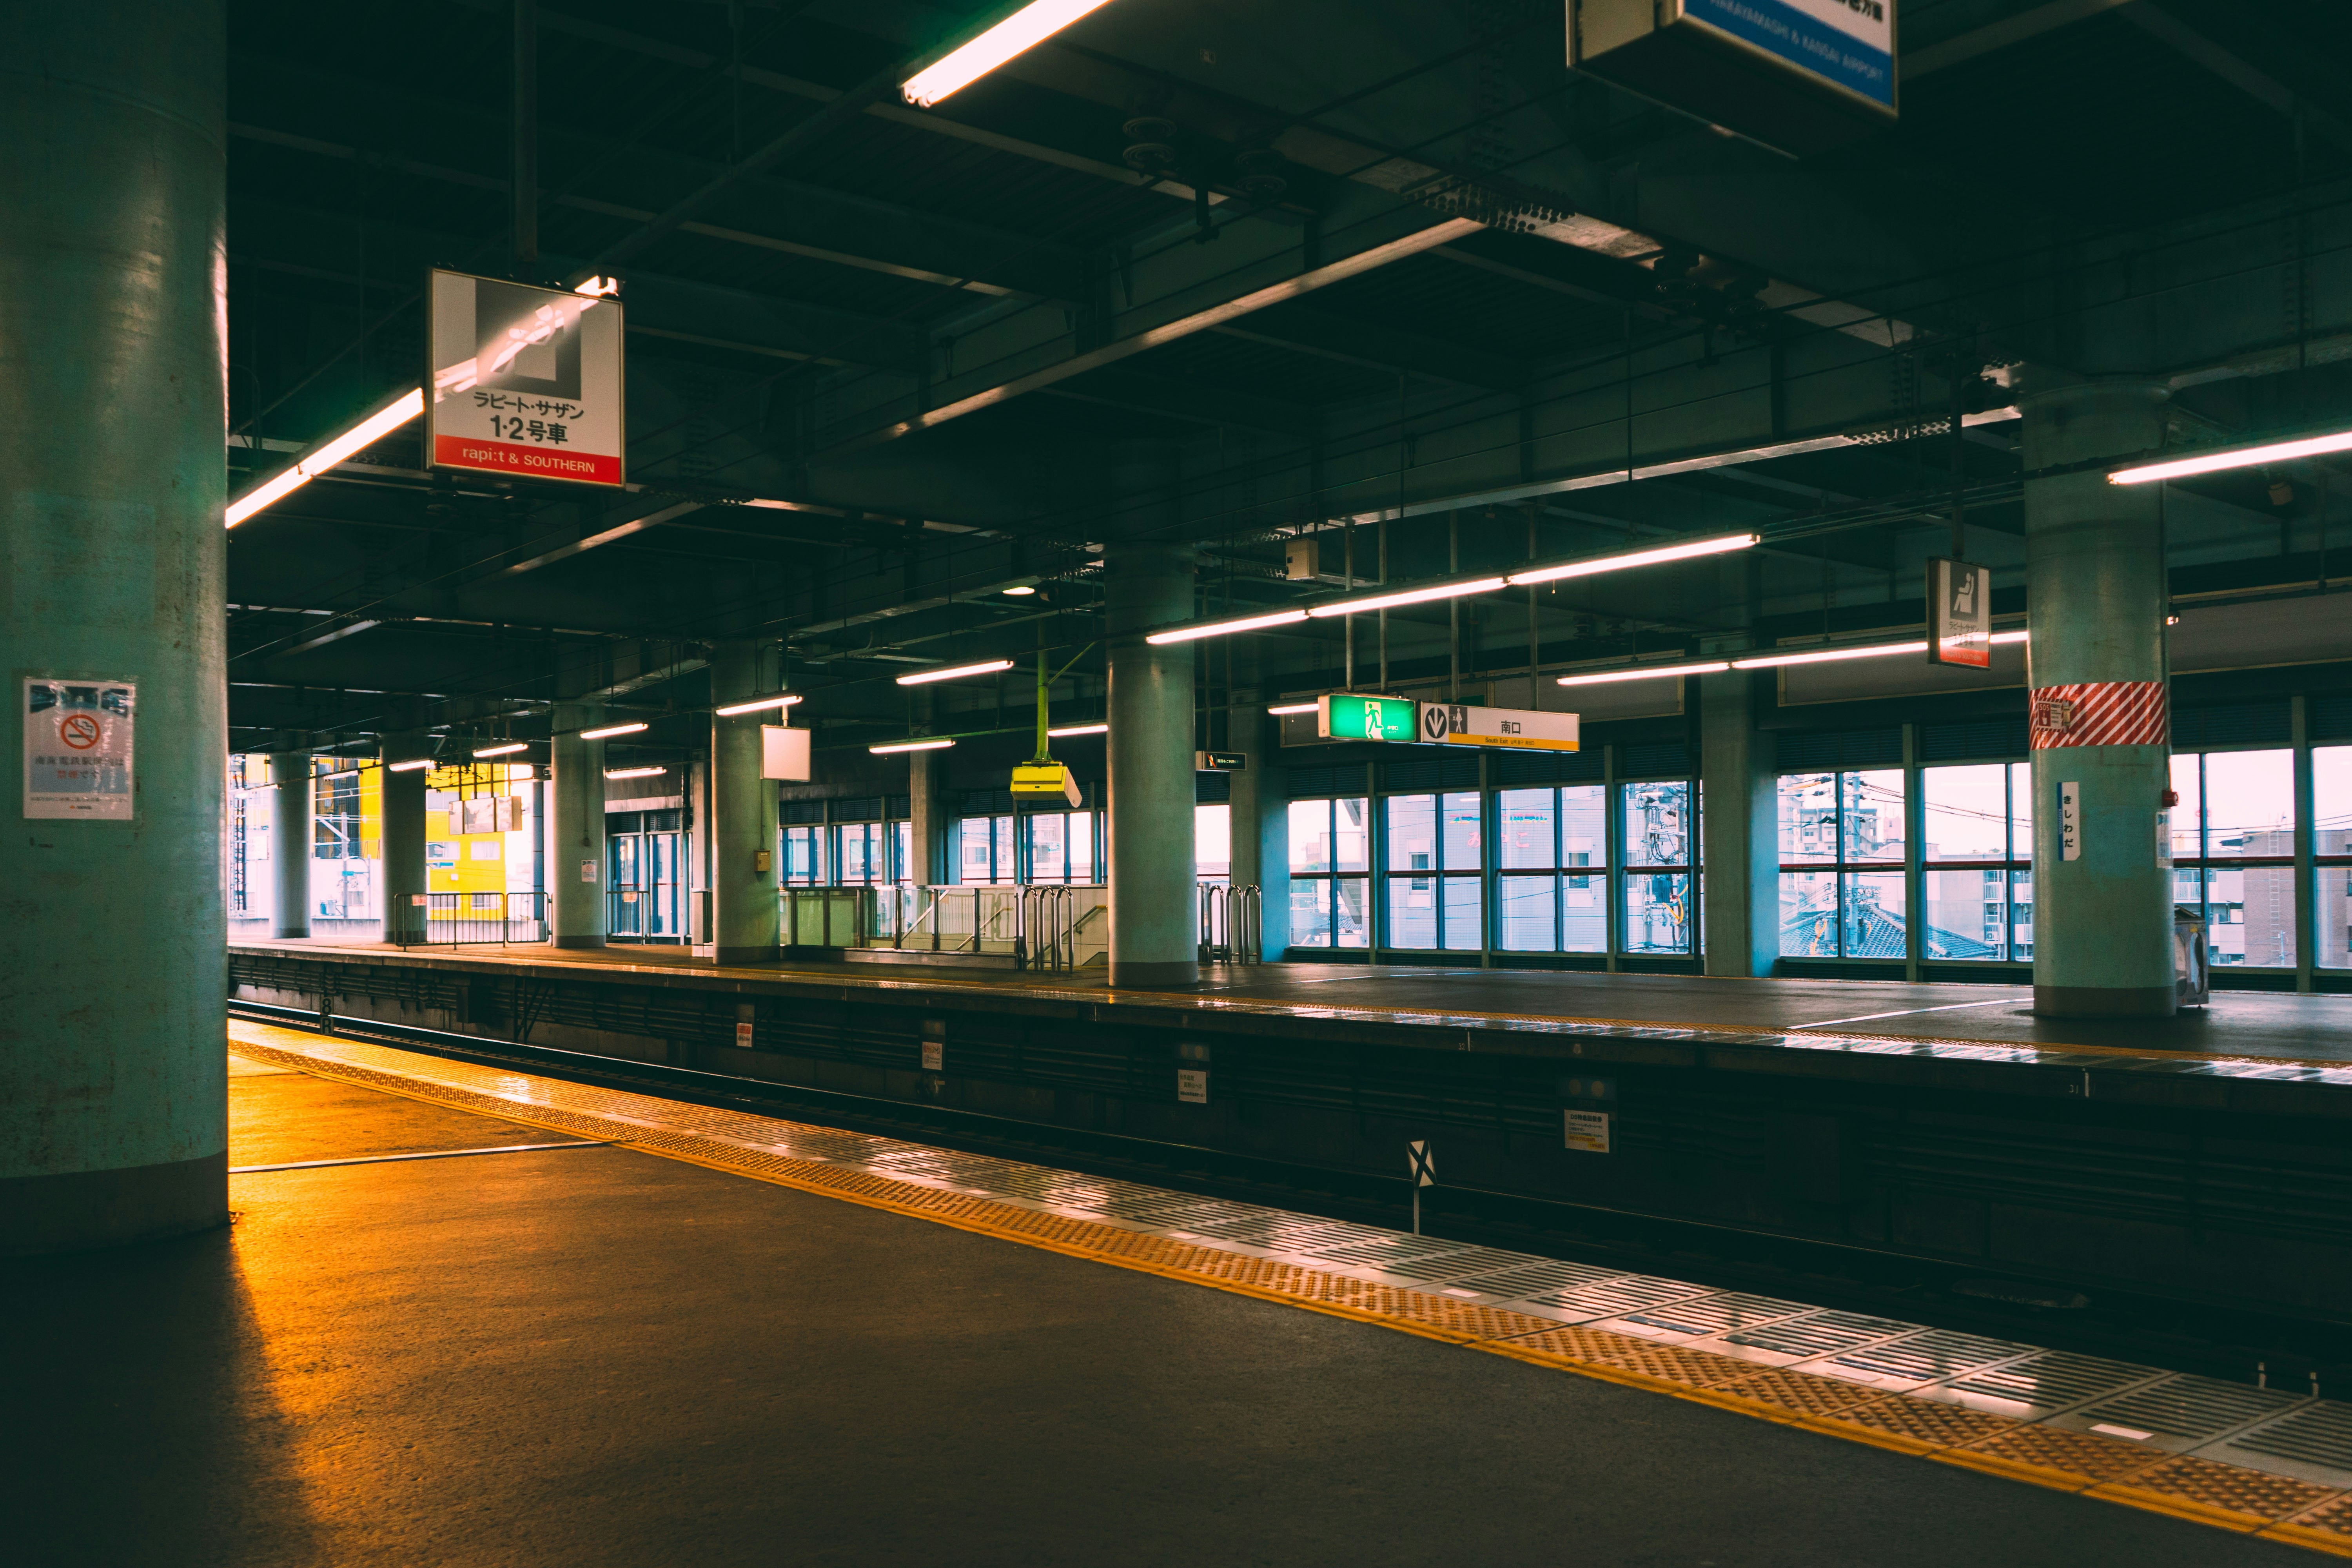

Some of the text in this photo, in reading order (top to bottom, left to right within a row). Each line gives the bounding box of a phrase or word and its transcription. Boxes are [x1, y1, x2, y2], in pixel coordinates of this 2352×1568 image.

[1802, 36, 1840, 63] KANSAI
[1843, 54, 1883, 80] AIRPORT
[474, 392, 584, 419] ラピート・サザン
[463, 447, 595, 473] rapi:t & SOUTHERN
[1501, 720, 1521, 734] 南口
[2063, 795, 2073, 848] きしわだ
[322, 998, 332, 1014] 8
[322, 1018, 332, 1034] R
[2069, 1084, 2079, 1094] 31
